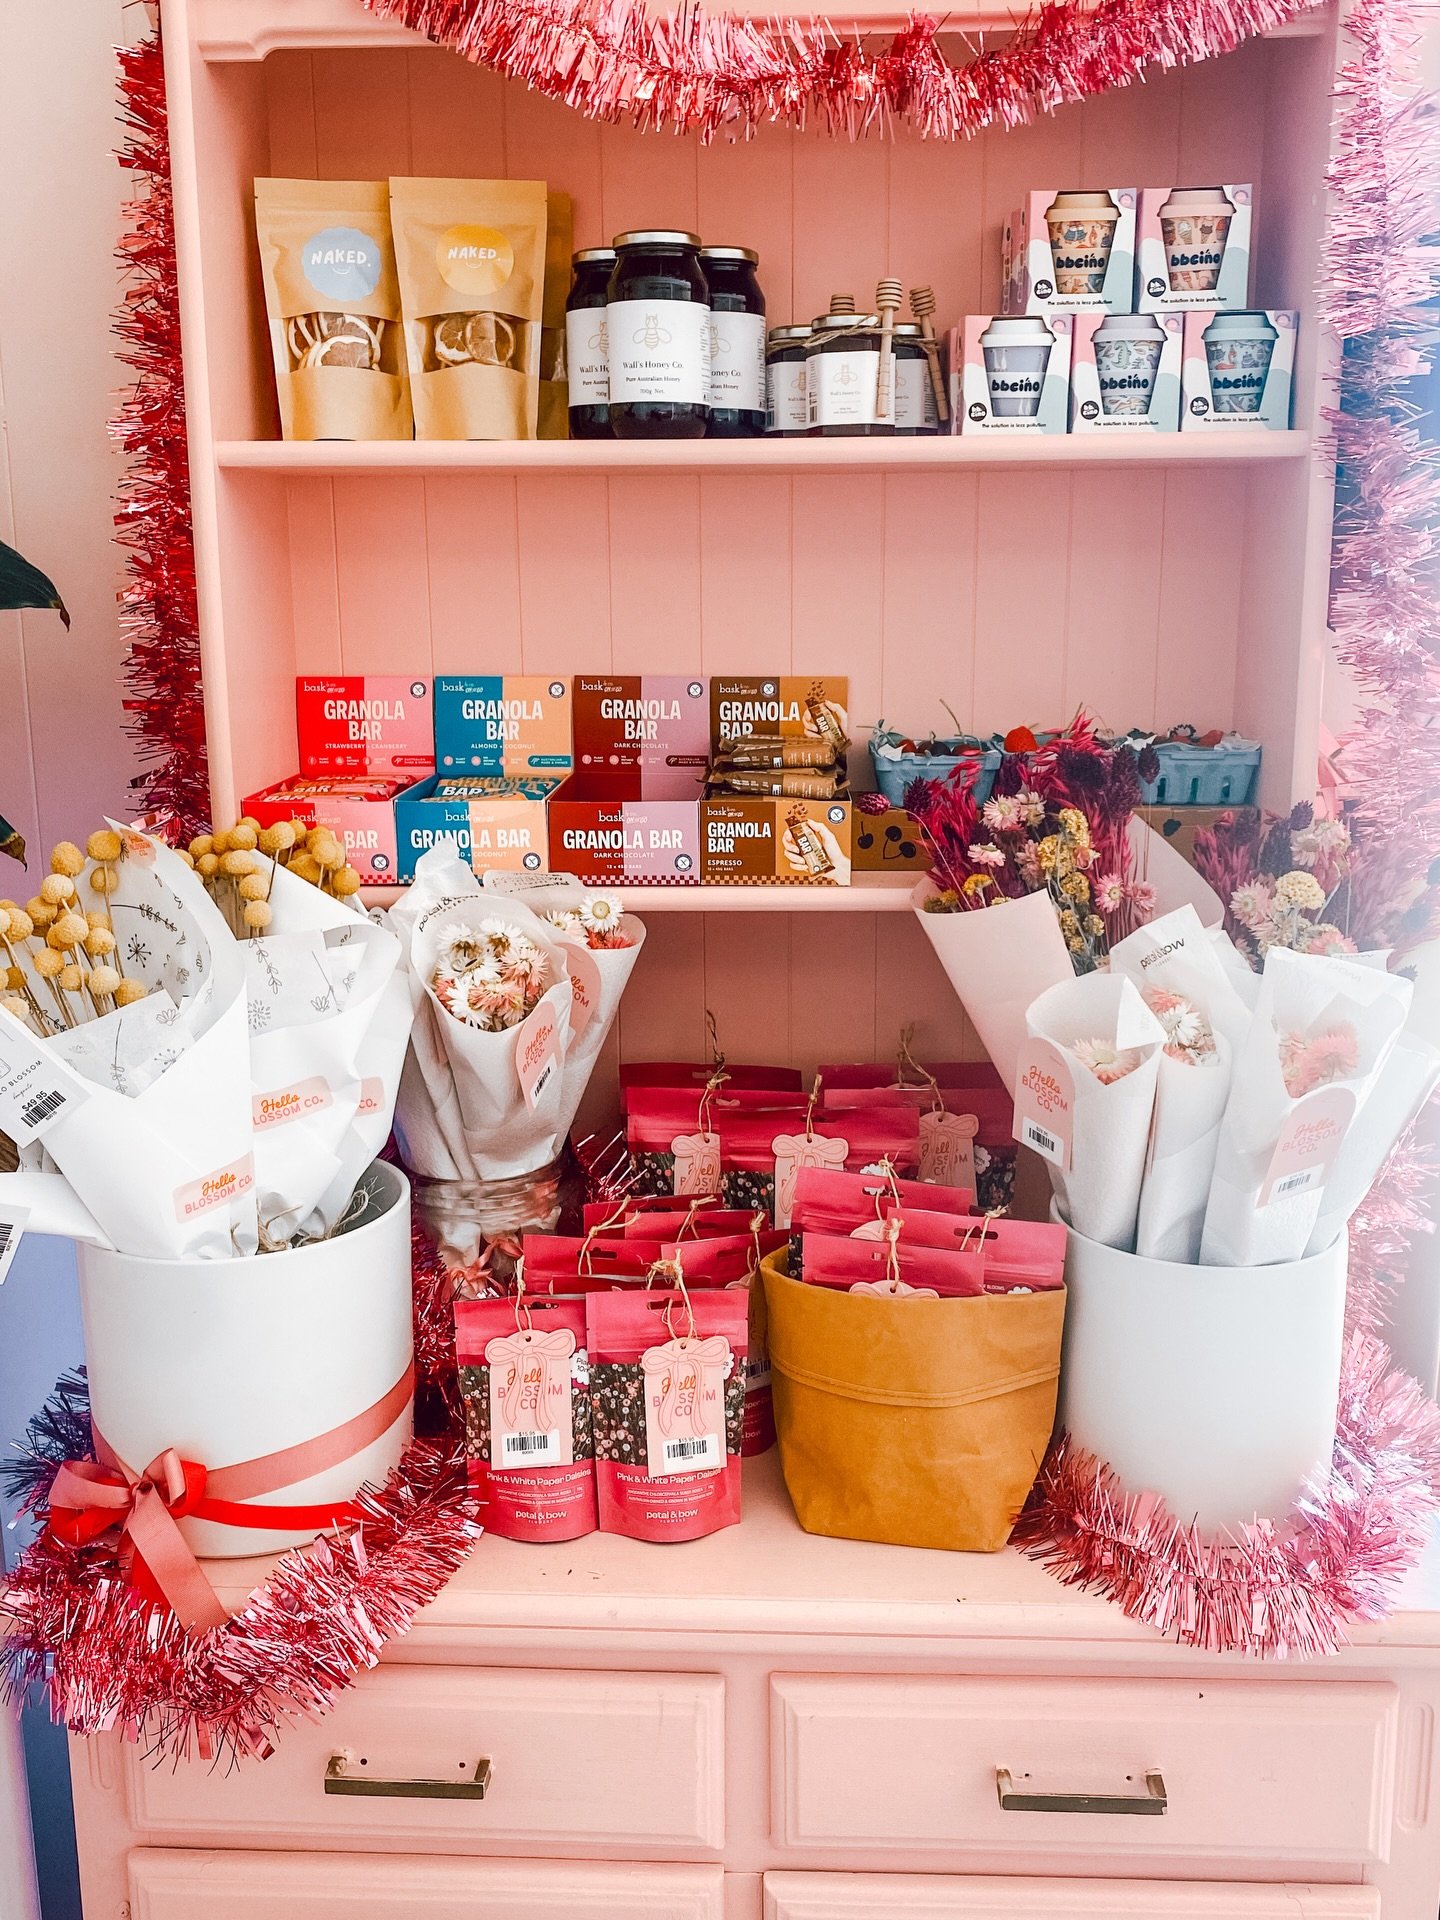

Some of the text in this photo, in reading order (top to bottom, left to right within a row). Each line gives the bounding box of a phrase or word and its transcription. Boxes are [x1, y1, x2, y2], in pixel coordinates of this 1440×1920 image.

[311, 249, 372, 267] NAKED.
[448, 246, 501, 262] NAKED.
[622, 361, 643, 369] Wall's
[645, 361, 670, 370] Honey
[711, 369, 729, 378] oney
[304, 681, 326, 692] bask
[442, 681, 465, 692] bask
[581, 680, 603, 691] bask
[720, 683, 740, 694] bask
[324, 700, 405, 720] GRANOLA
[462, 700, 543, 720] GRANOLA
[601, 699, 681, 720] GRANOLA
[720, 701, 800, 721] GRANOLA
[348, 721, 382, 740] BAR
[486, 721, 519, 740] BAR
[624, 720, 658, 740] BAR
[720, 722, 753, 740] BAR
[445, 809, 471, 822] bask
[598, 810, 625, 823] bask
[707, 806, 727, 817] bask
[497, 829, 531, 849] BAR
[707, 822, 772, 838] GRANOLA
[343, 830, 378, 849] BAR
[563, 830, 683, 849] GRANOLA BAR
[708, 838, 735, 853] BAR
[798, 836, 812, 854] BAR
[571, 975, 585, 993] llo
[522, 1024, 553, 1073] BLOSSOM
[525, 1025, 547, 1060] Hello
[8, 1060, 43, 1087] BLOSSOM
[1030, 1065, 1062, 1095] Hello
[1022, 1075, 1068, 1112] BLOSSOM
[253, 1095, 324, 1126] LOSSOM CO.
[261, 1093, 300, 1113] Hello
[1037, 1095, 1053, 1113] CO.
[1294, 1118, 1335, 1139] Hello
[1282, 1127, 1343, 1152] BLOSSOM
[201, 1172, 237, 1197] Hello
[184, 1174, 253, 1214] BLOSSOM CO.
[507, 1368, 552, 1386] ell
[662, 1374, 705, 1393] ell
[498, 1384, 562, 1399] BOSSM
[653, 1389, 716, 1408] BSSM
[486, 1468, 592, 1486] Pink & White Paper Daisies
[616, 1472, 633, 1482] Pink
[634, 1475, 640, 1483] &
[642, 1475, 668, 1485] White
[669, 1475, 696, 1485] Paper
[516, 1510, 567, 1520] petal & bow
[646, 1509, 698, 1520] petal & bow
